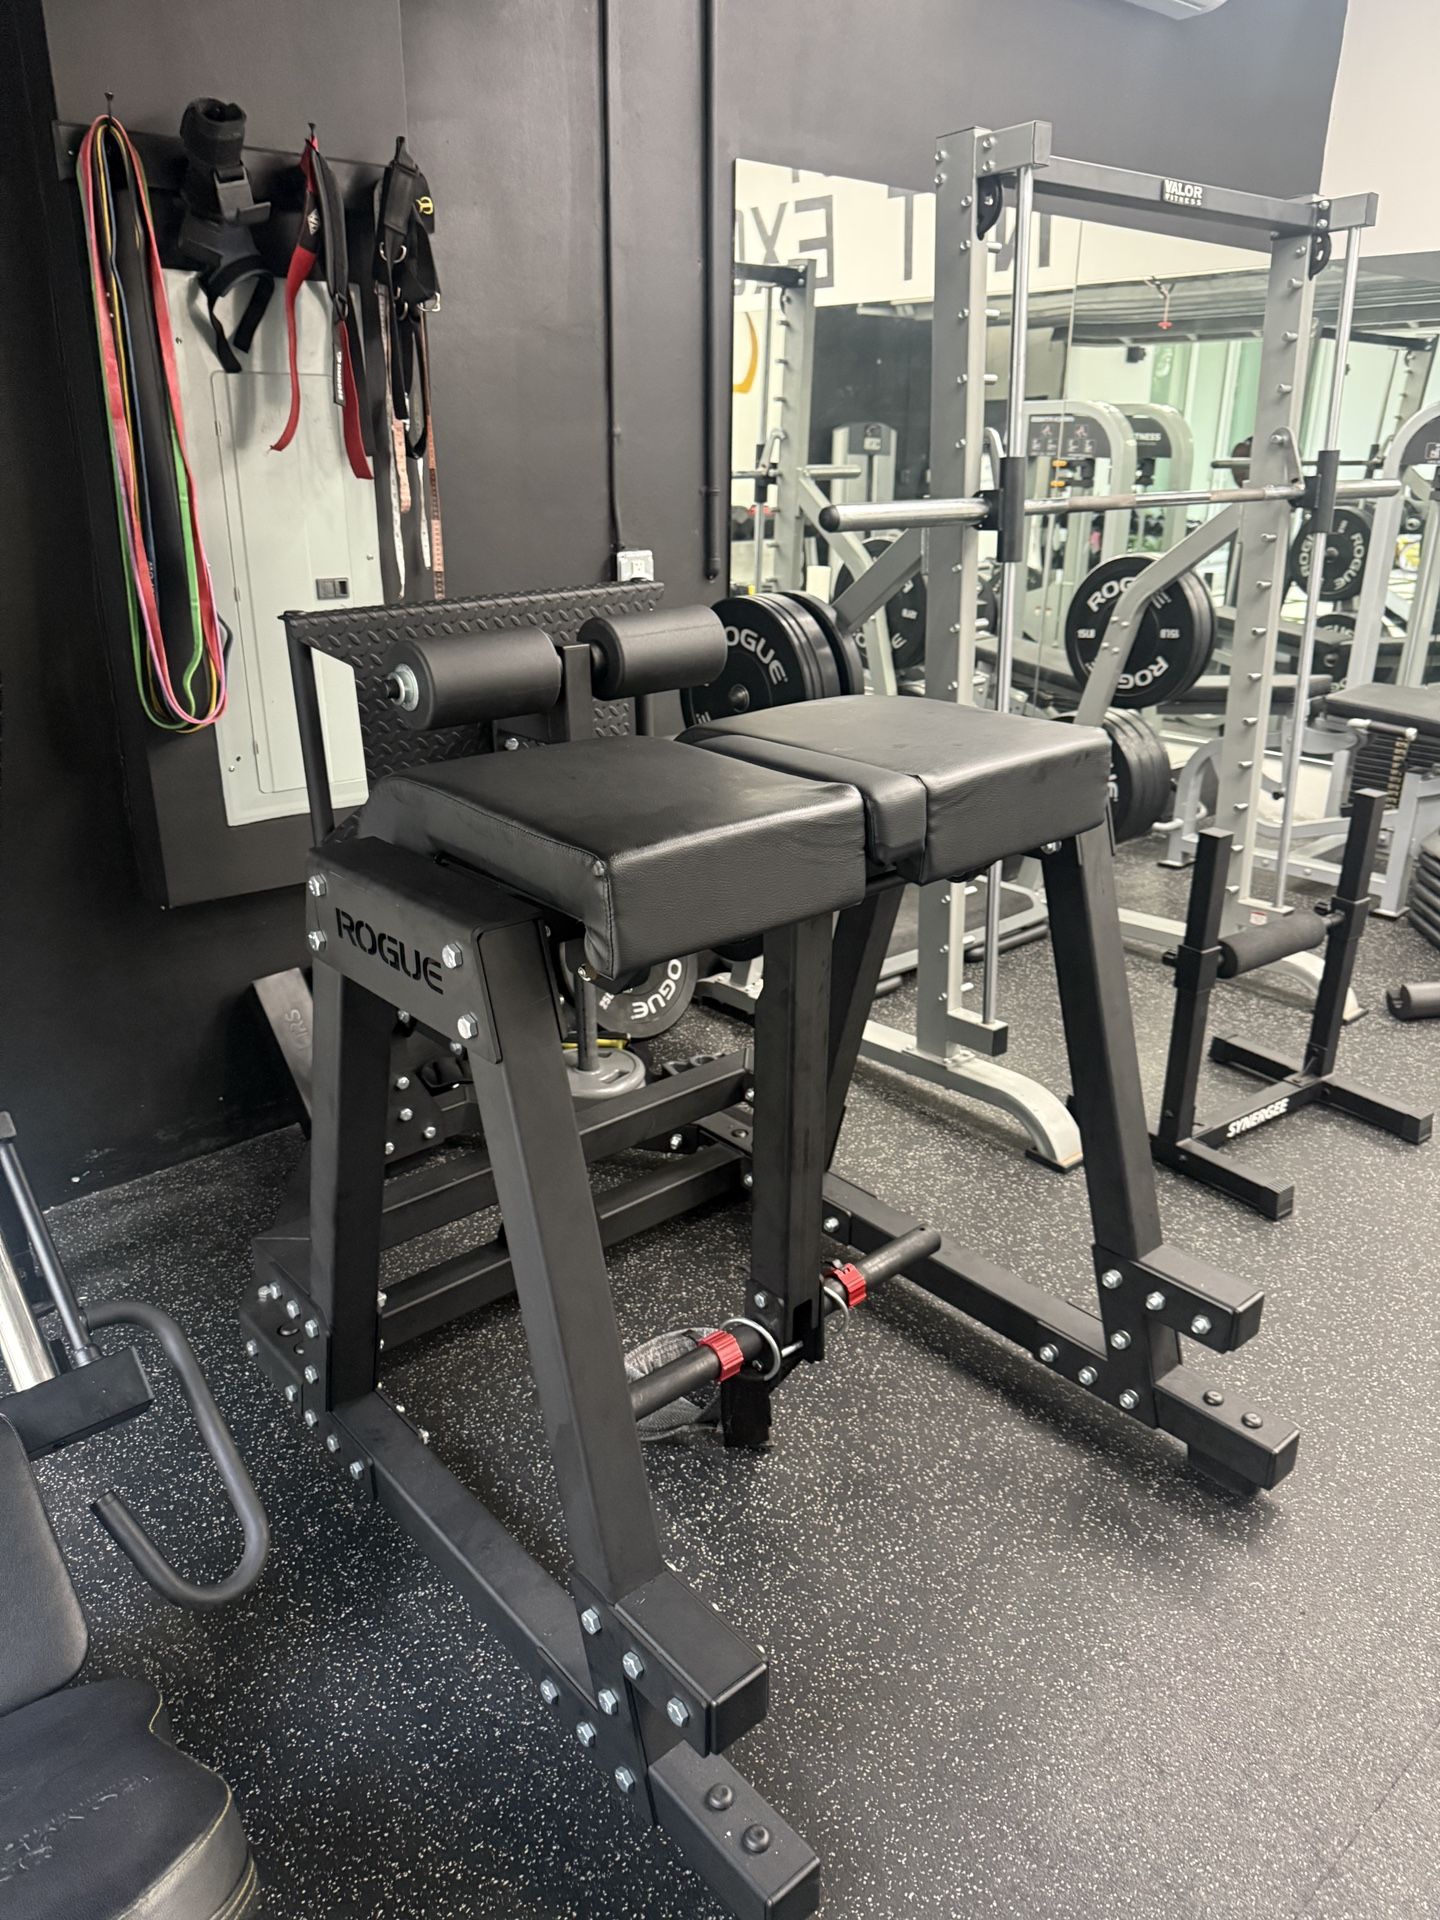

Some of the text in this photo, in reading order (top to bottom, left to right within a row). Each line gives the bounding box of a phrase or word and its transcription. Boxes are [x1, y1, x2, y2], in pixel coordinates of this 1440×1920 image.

[1164, 193, 1202, 206] FITNESS
[1165, 179, 1203, 199] VALOR
[1333, 532, 1366, 591] ROGUE
[1086, 576, 1138, 613] ROG
[724, 625, 786, 686] OGUE
[335, 906, 444, 996] ROGUE
[630, 958, 683, 1021] OGUE
[1226, 1097, 1290, 1138] SYNERGEE
